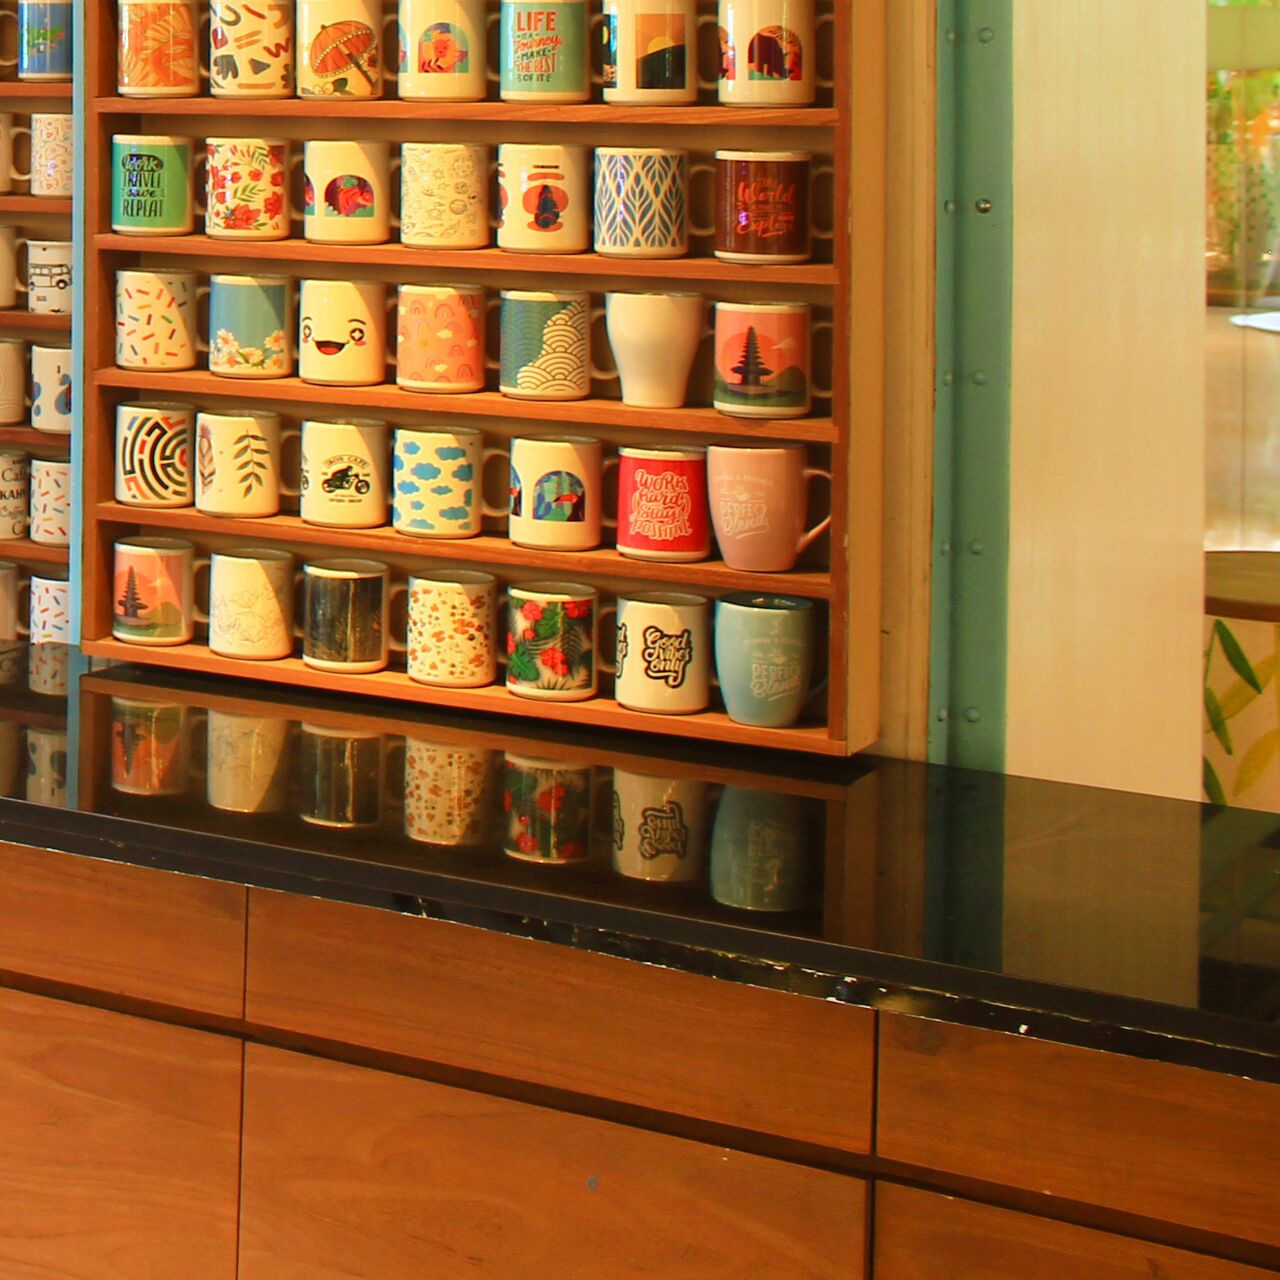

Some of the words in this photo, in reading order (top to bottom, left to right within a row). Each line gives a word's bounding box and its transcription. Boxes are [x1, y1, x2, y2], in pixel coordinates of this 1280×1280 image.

[517, 11, 557, 32] LIFE
[521, 48, 547, 60] MAKE
[517, 60, 531, 73] THE
[122, 199, 163, 217] REPEAT
[634, 469, 688, 492] WORK
[649, 658, 685, 686] only
